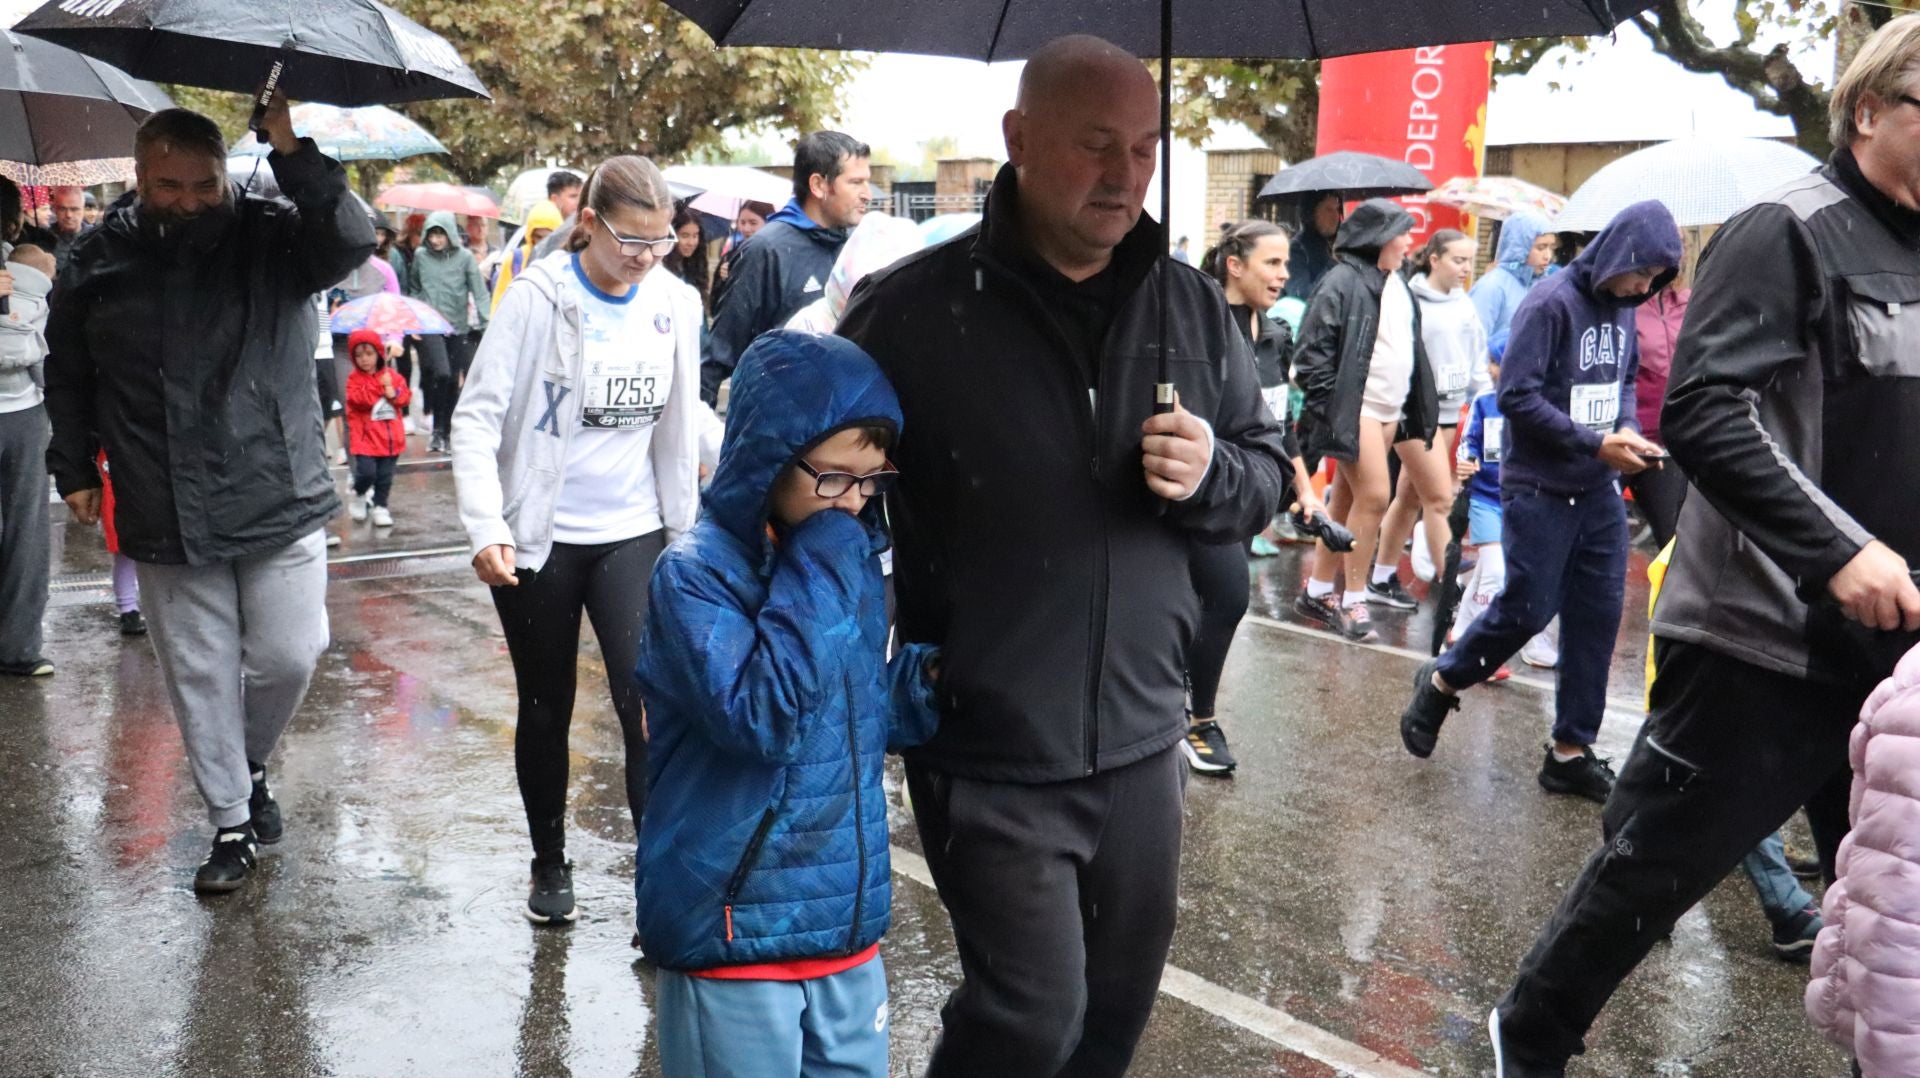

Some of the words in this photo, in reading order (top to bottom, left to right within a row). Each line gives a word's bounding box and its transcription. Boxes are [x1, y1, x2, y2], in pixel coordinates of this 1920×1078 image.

[265, 61, 283, 91] FUCKING
[260, 89, 273, 106] RAIN
[606, 377, 655, 406] 1253
[534, 380, 571, 438] X
